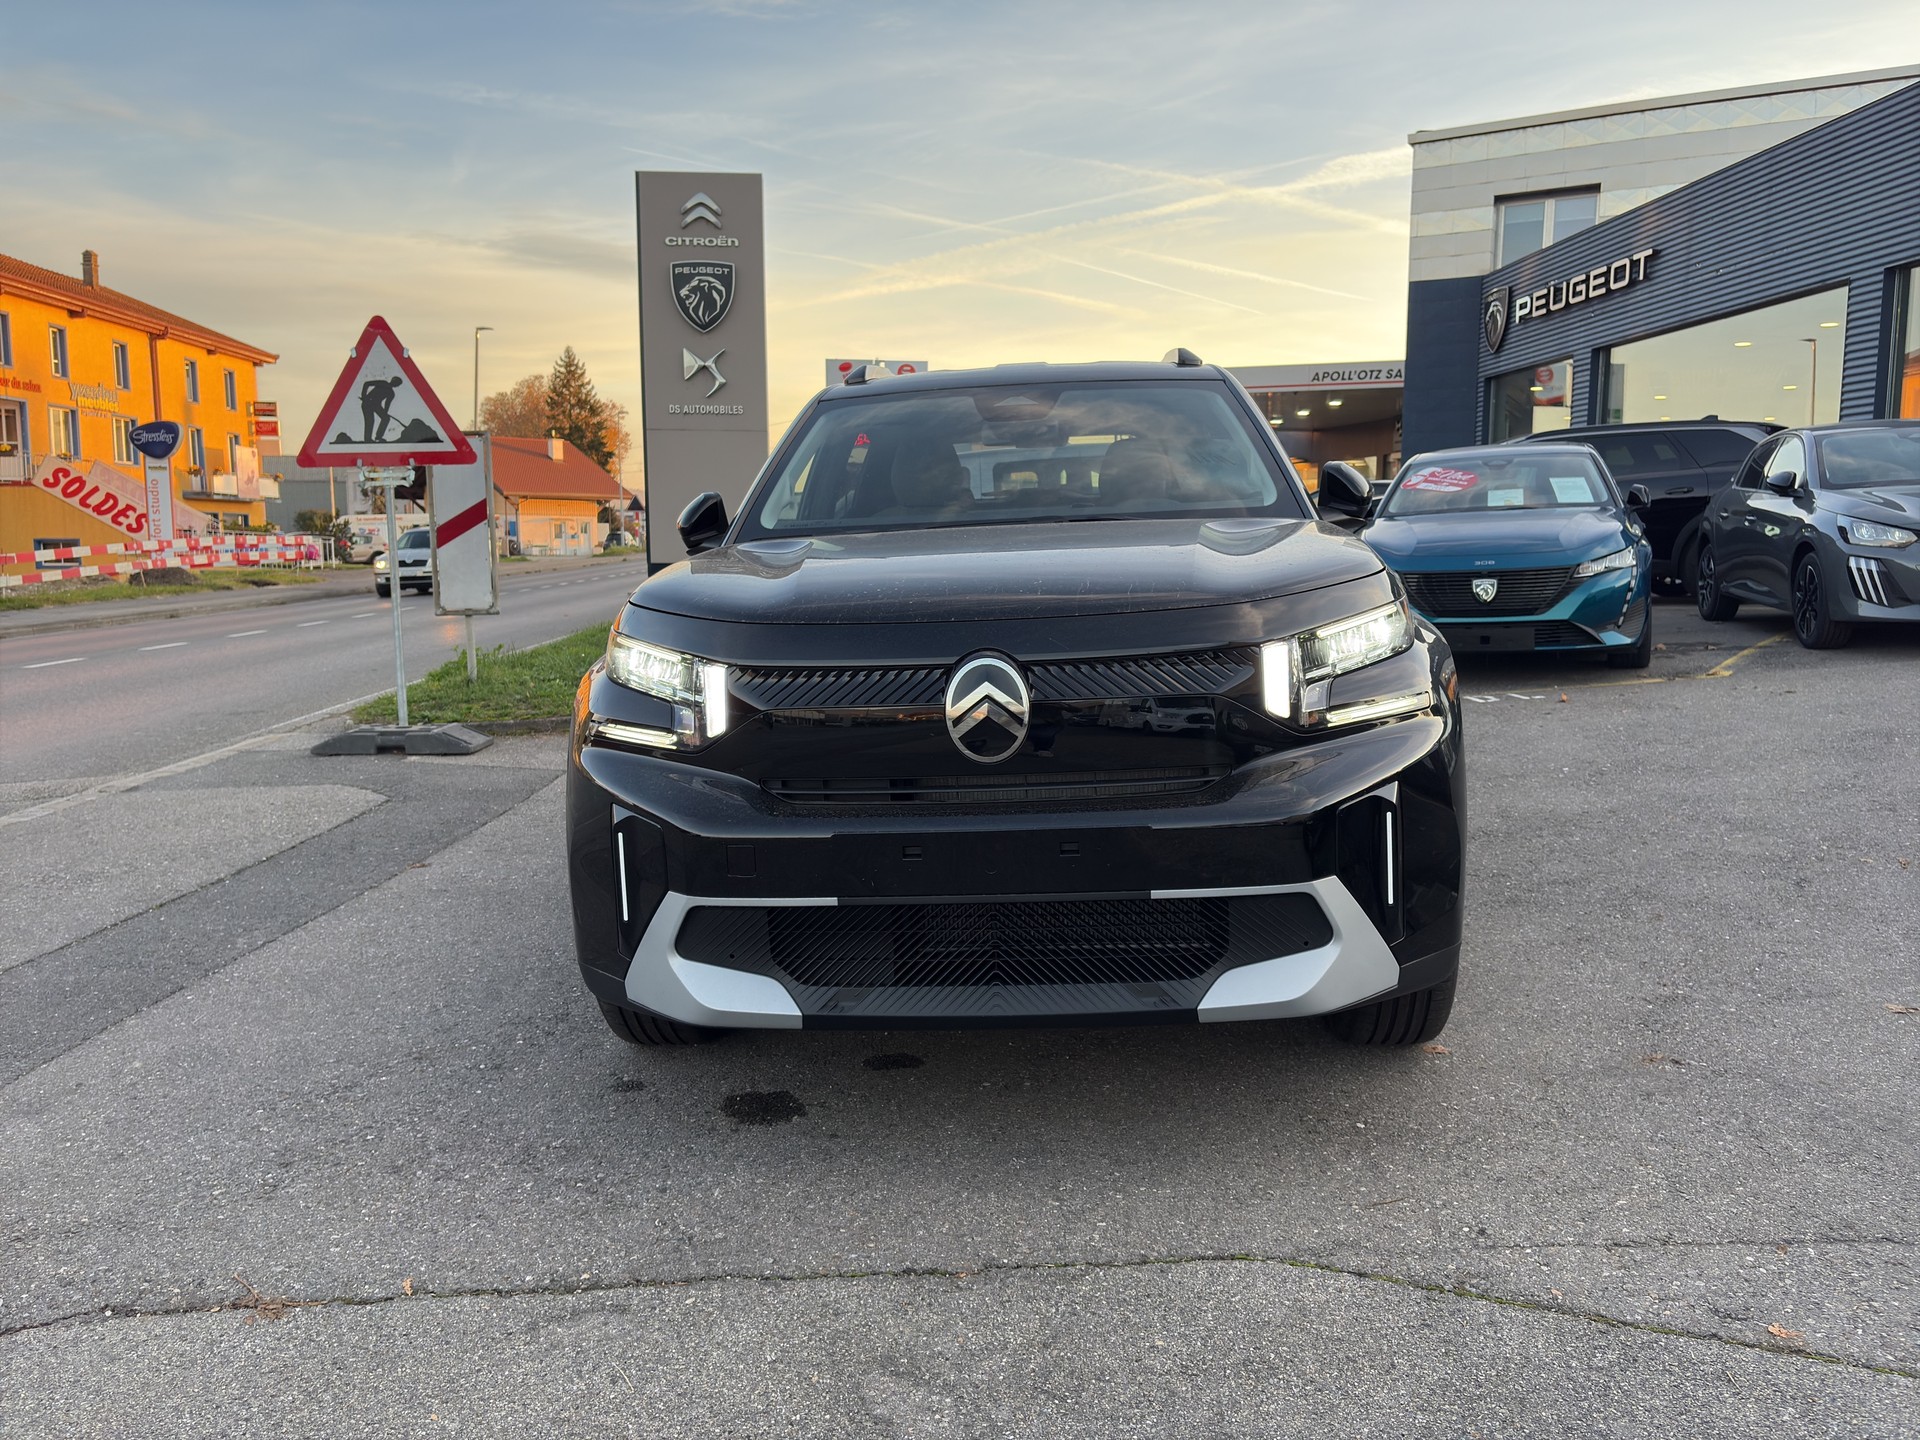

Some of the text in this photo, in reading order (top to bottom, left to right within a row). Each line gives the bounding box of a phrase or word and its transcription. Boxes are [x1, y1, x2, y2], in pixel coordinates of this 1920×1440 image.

[674, 266, 730, 275] PEUGEOT
[1515, 248, 1653, 324] PEUGEOT
[1311, 368, 1403, 382] APOLL'OTZ SA
[669, 404, 744, 415] DS AUTOMOBILES
[132, 429, 175, 444] Stressless
[43, 467, 147, 533] SOLDES
[149, 479, 161, 514] studio
